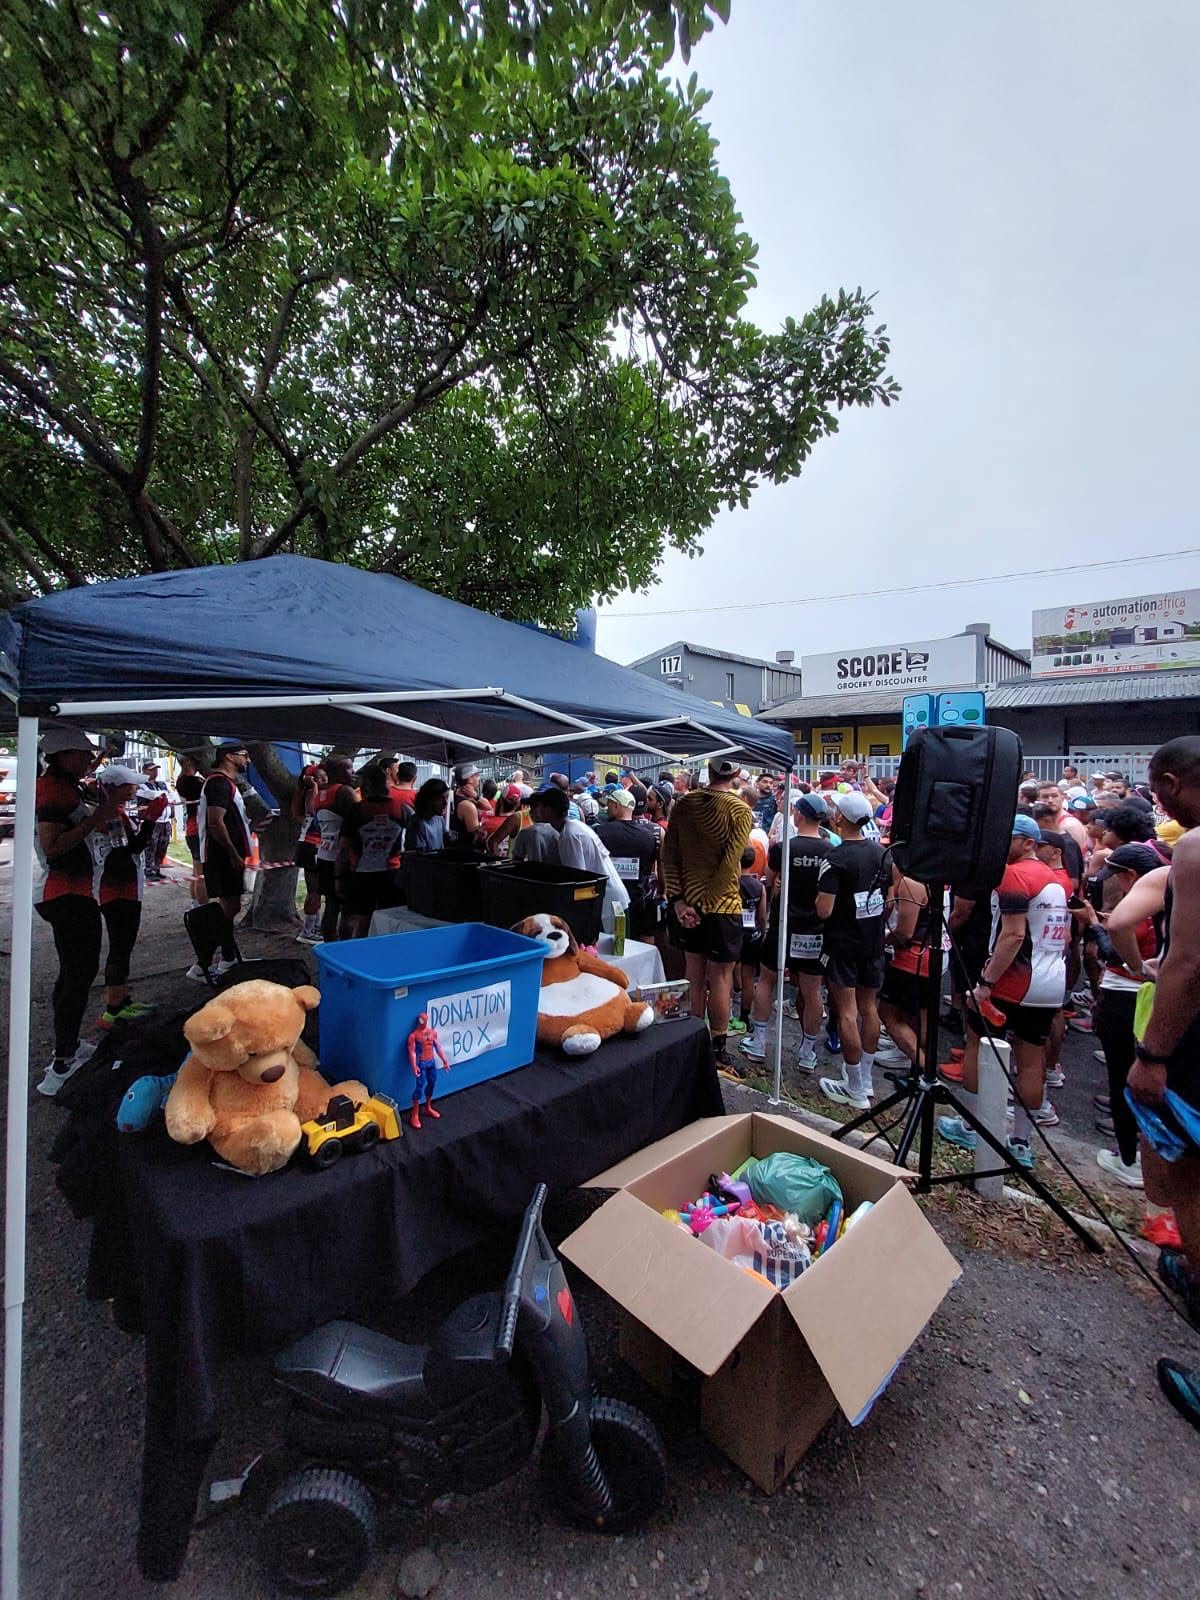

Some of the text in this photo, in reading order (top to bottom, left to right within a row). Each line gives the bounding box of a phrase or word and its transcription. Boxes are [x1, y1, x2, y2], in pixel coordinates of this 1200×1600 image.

[1093, 596, 1186, 619] automationafrica
[662, 656, 681, 673] 117
[837, 652, 903, 680] SCORE
[837, 675, 928, 690] GROCERY DISCOUNTER
[430, 988, 506, 1029] DONATION
[452, 1021, 491, 1057] BOX
